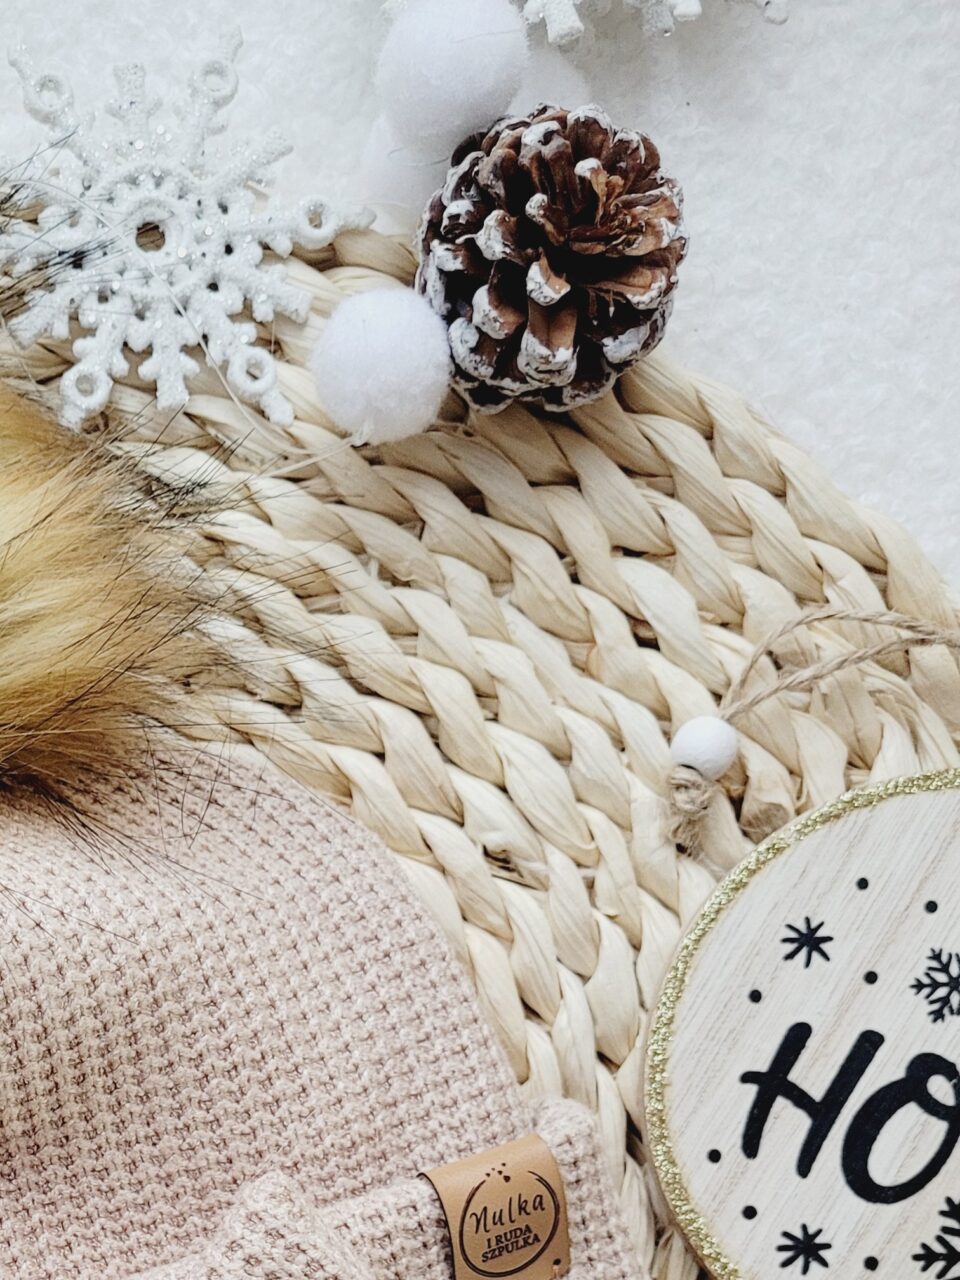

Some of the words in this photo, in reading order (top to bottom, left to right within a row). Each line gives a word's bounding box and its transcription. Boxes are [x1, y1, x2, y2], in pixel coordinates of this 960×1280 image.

[470, 1193, 545, 1234] Nulka
[482, 1234, 541, 1263] SZPULKA
[487, 1238, 492, 1249] I
[495, 1225, 533, 1245] RUDA
